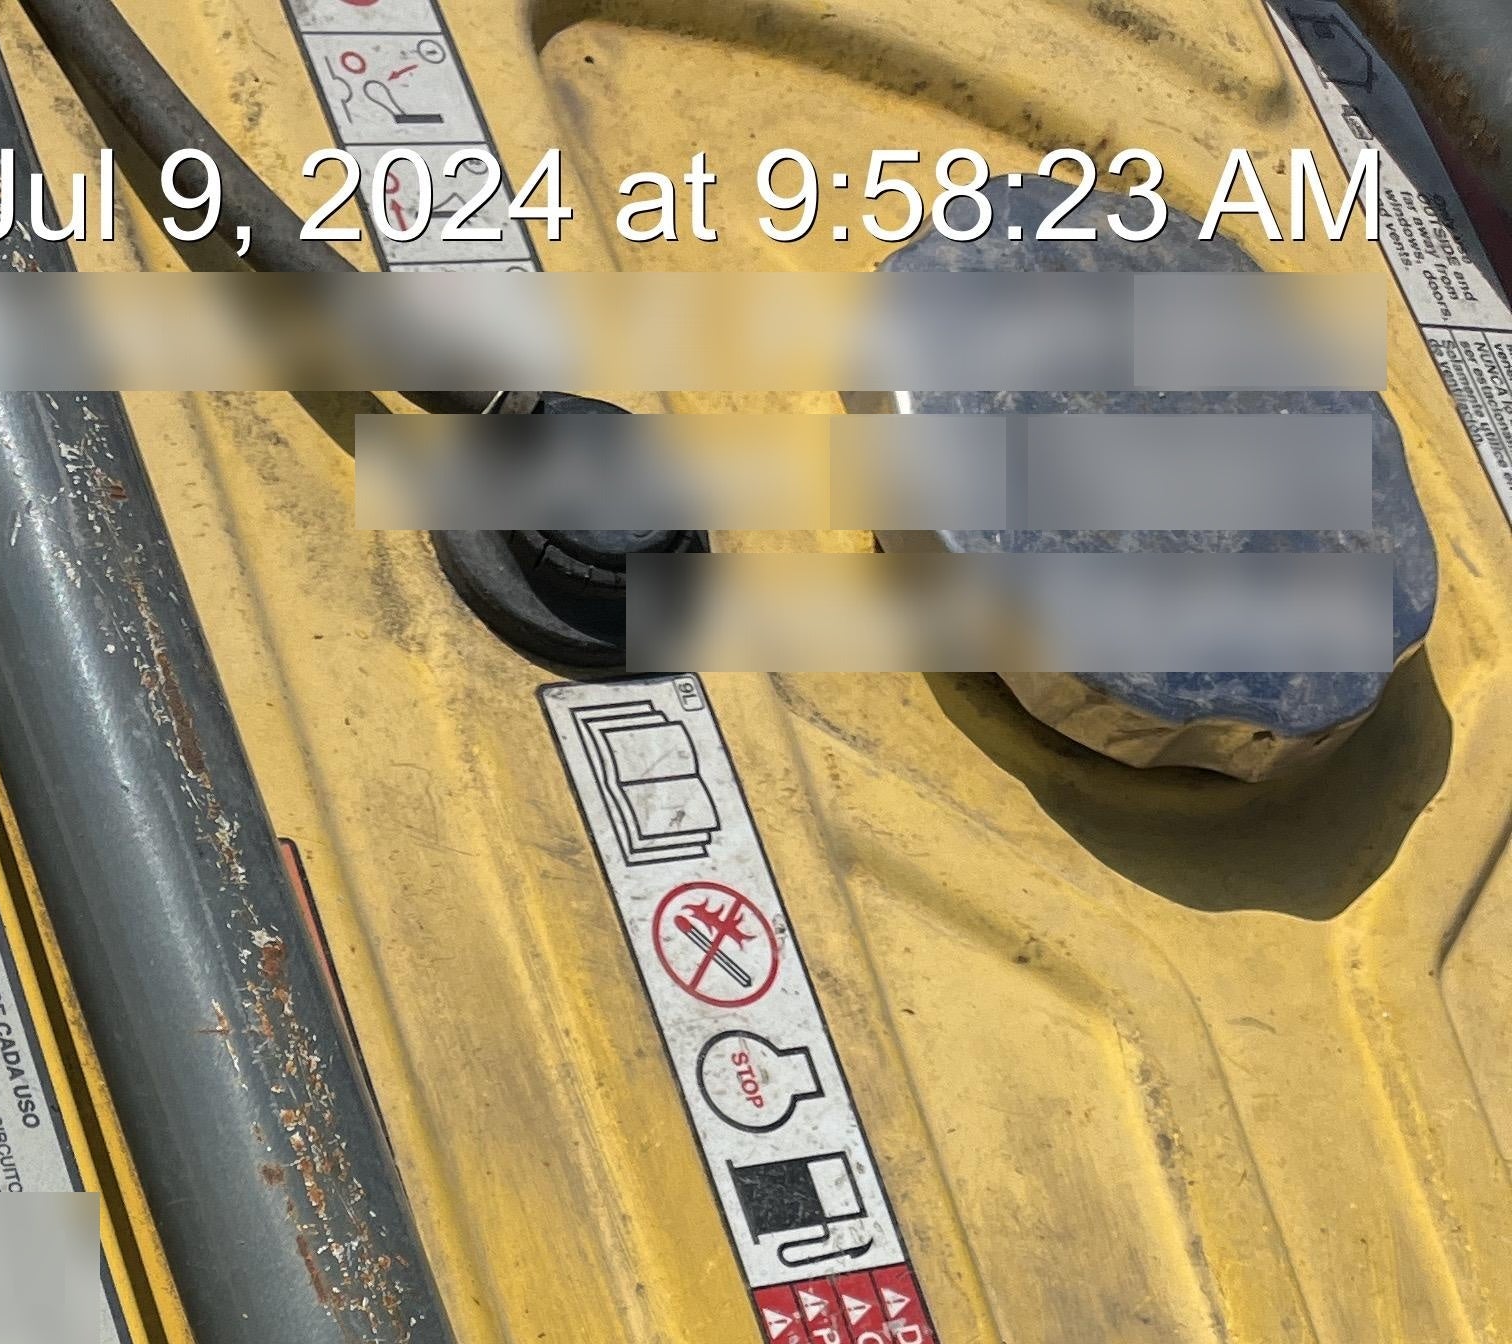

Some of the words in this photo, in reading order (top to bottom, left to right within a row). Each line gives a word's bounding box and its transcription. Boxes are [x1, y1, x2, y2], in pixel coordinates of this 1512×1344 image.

[1434, 263, 1459, 300] from
[1453, 270, 1478, 302] and
[1474, 341, 1507, 396] NUNCA
[677, 681, 698, 705] 9L
[729, 1049, 765, 1111] STOP
[10, 1083, 42, 1129] USO
